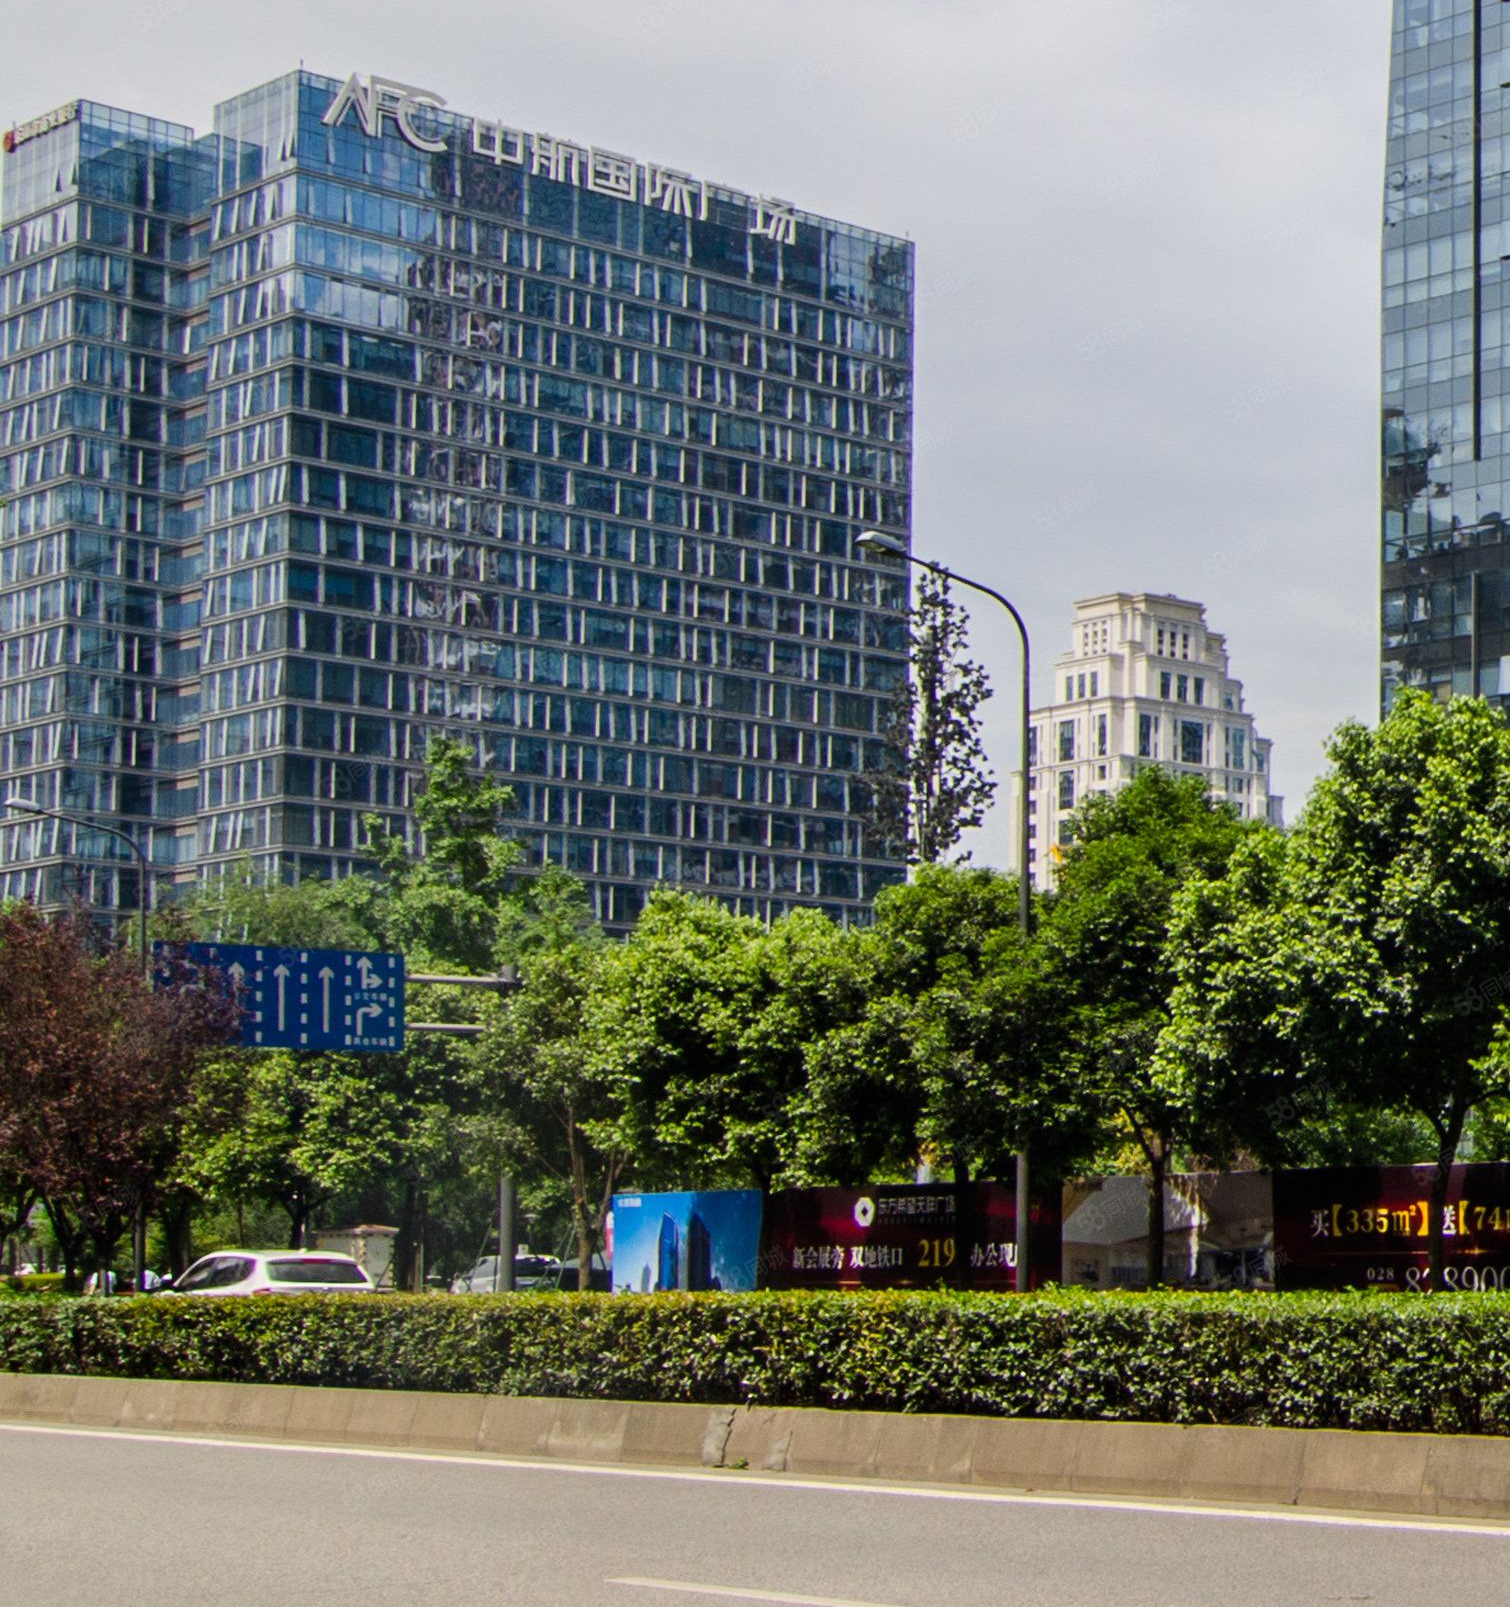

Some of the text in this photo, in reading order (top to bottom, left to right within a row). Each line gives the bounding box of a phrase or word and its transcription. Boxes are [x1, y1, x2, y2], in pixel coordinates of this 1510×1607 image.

[320, 71, 796, 246] AFC 中航国际广场
[917, 1236, 957, 1268] 219
[1366, 1267, 1395, 1281] 028
